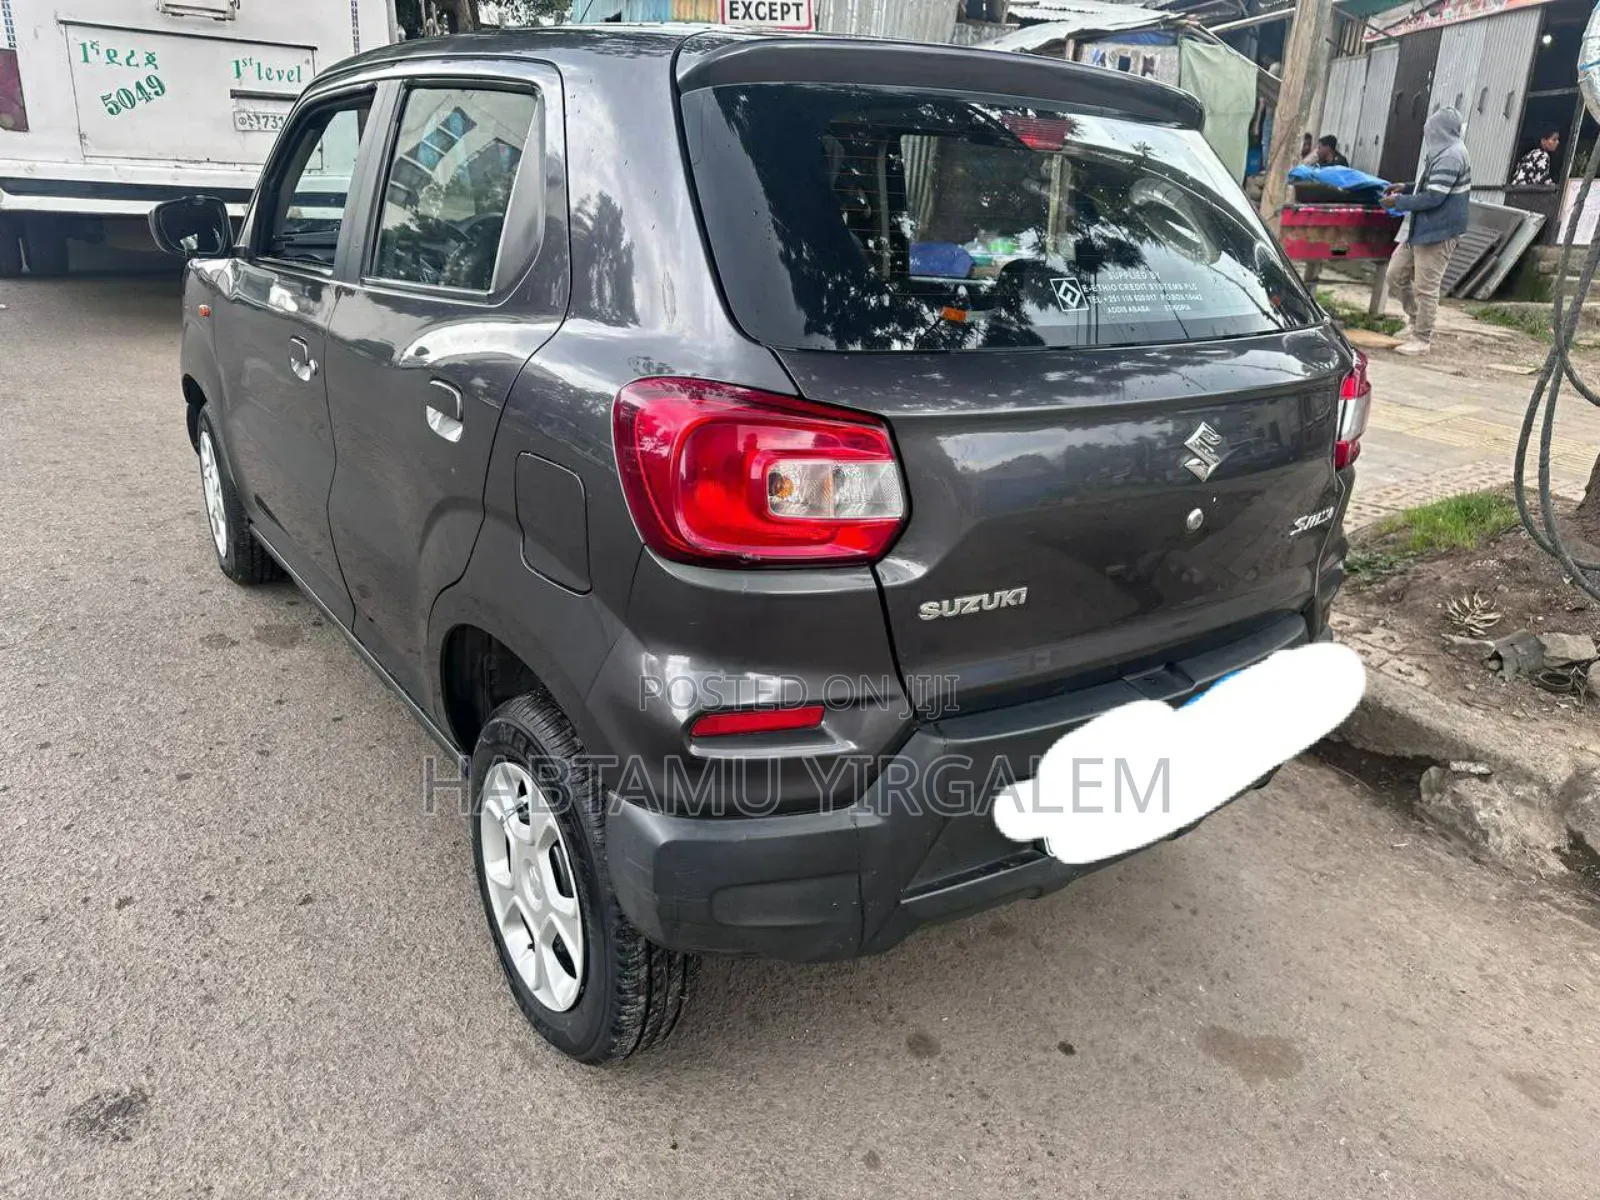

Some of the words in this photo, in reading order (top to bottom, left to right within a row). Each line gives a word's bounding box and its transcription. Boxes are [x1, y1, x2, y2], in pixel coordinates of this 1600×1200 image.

[729, 0, 804, 21] EXCEPT
[256, 62, 302, 83] level
[100, 74, 166, 116] 5049
[918, 587, 1028, 621] SUZUKI
